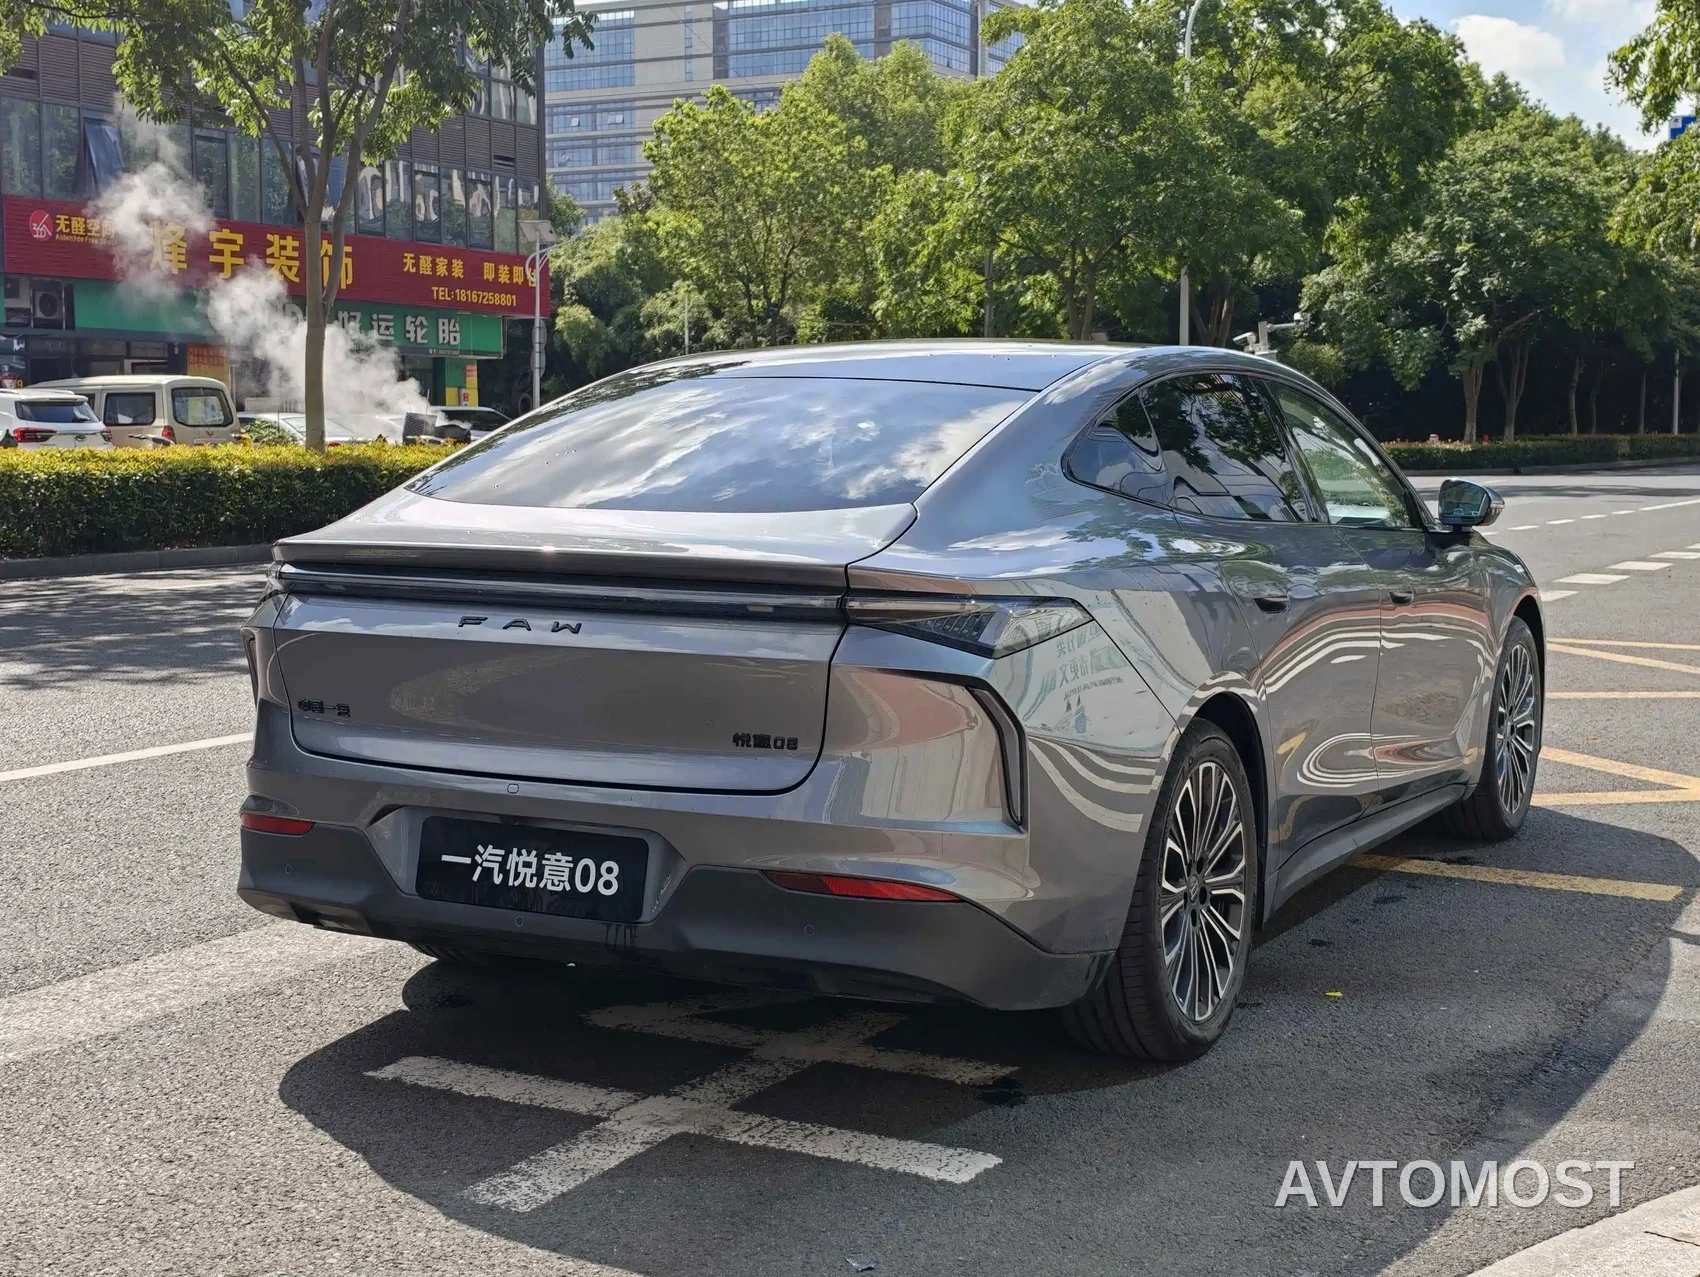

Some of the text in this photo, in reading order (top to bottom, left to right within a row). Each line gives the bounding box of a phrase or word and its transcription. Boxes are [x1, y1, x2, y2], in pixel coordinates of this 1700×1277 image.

[55, 214, 115, 238] 无醛空间
[403, 252, 464, 279] 无醛家装
[431, 286, 517, 307] TEL:18167258801
[458, 616, 582, 634] FAW
[441, 844, 620, 896] 一汽悦意08
